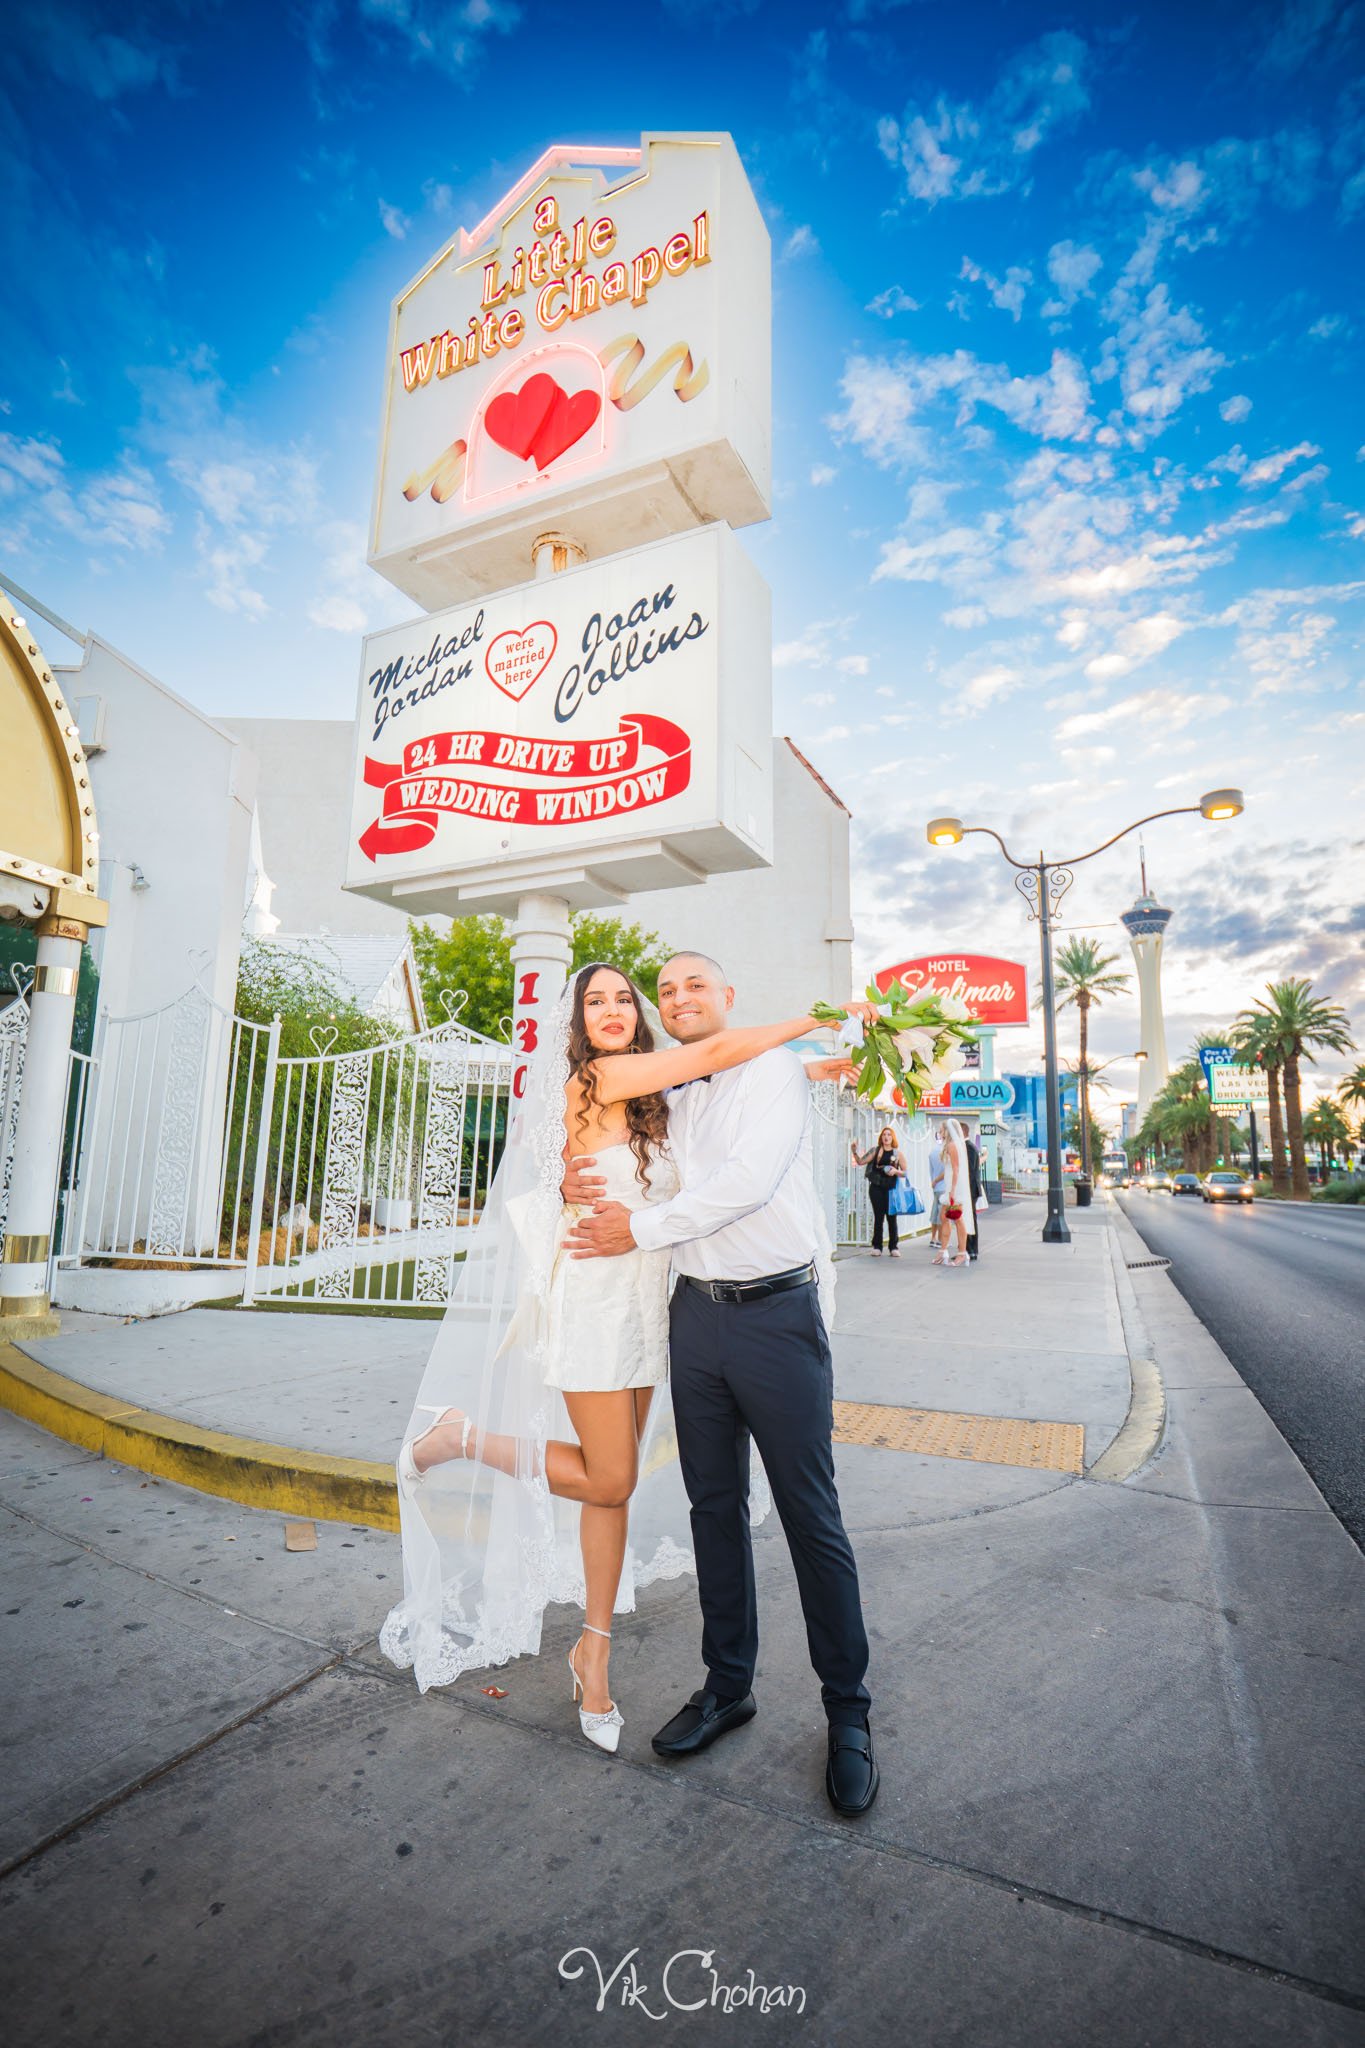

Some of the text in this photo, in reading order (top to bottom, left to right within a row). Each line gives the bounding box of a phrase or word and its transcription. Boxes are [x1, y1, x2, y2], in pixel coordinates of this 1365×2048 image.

[532, 195, 559, 235] a
[481, 216, 618, 311] Little
[400, 210, 713, 393] White Chapel
[505, 636, 536, 655] were
[582, 584, 678, 674] Joan
[368, 609, 485, 698] Michael
[494, 646, 546, 673] married
[554, 612, 710, 723] Collins
[504, 665, 534, 686] here
[372, 659, 473, 742] Jordan
[410, 735, 628, 773] 24 HR DRIVE UP
[399, 766, 668, 822] WEDDING WINDOW
[928, 960, 970, 972] HOTEL
[900, 970, 1016, 1002] Salimar
[1203, 1055, 1233, 1064] MOT
[954, 1085, 1004, 1099] AQUA
